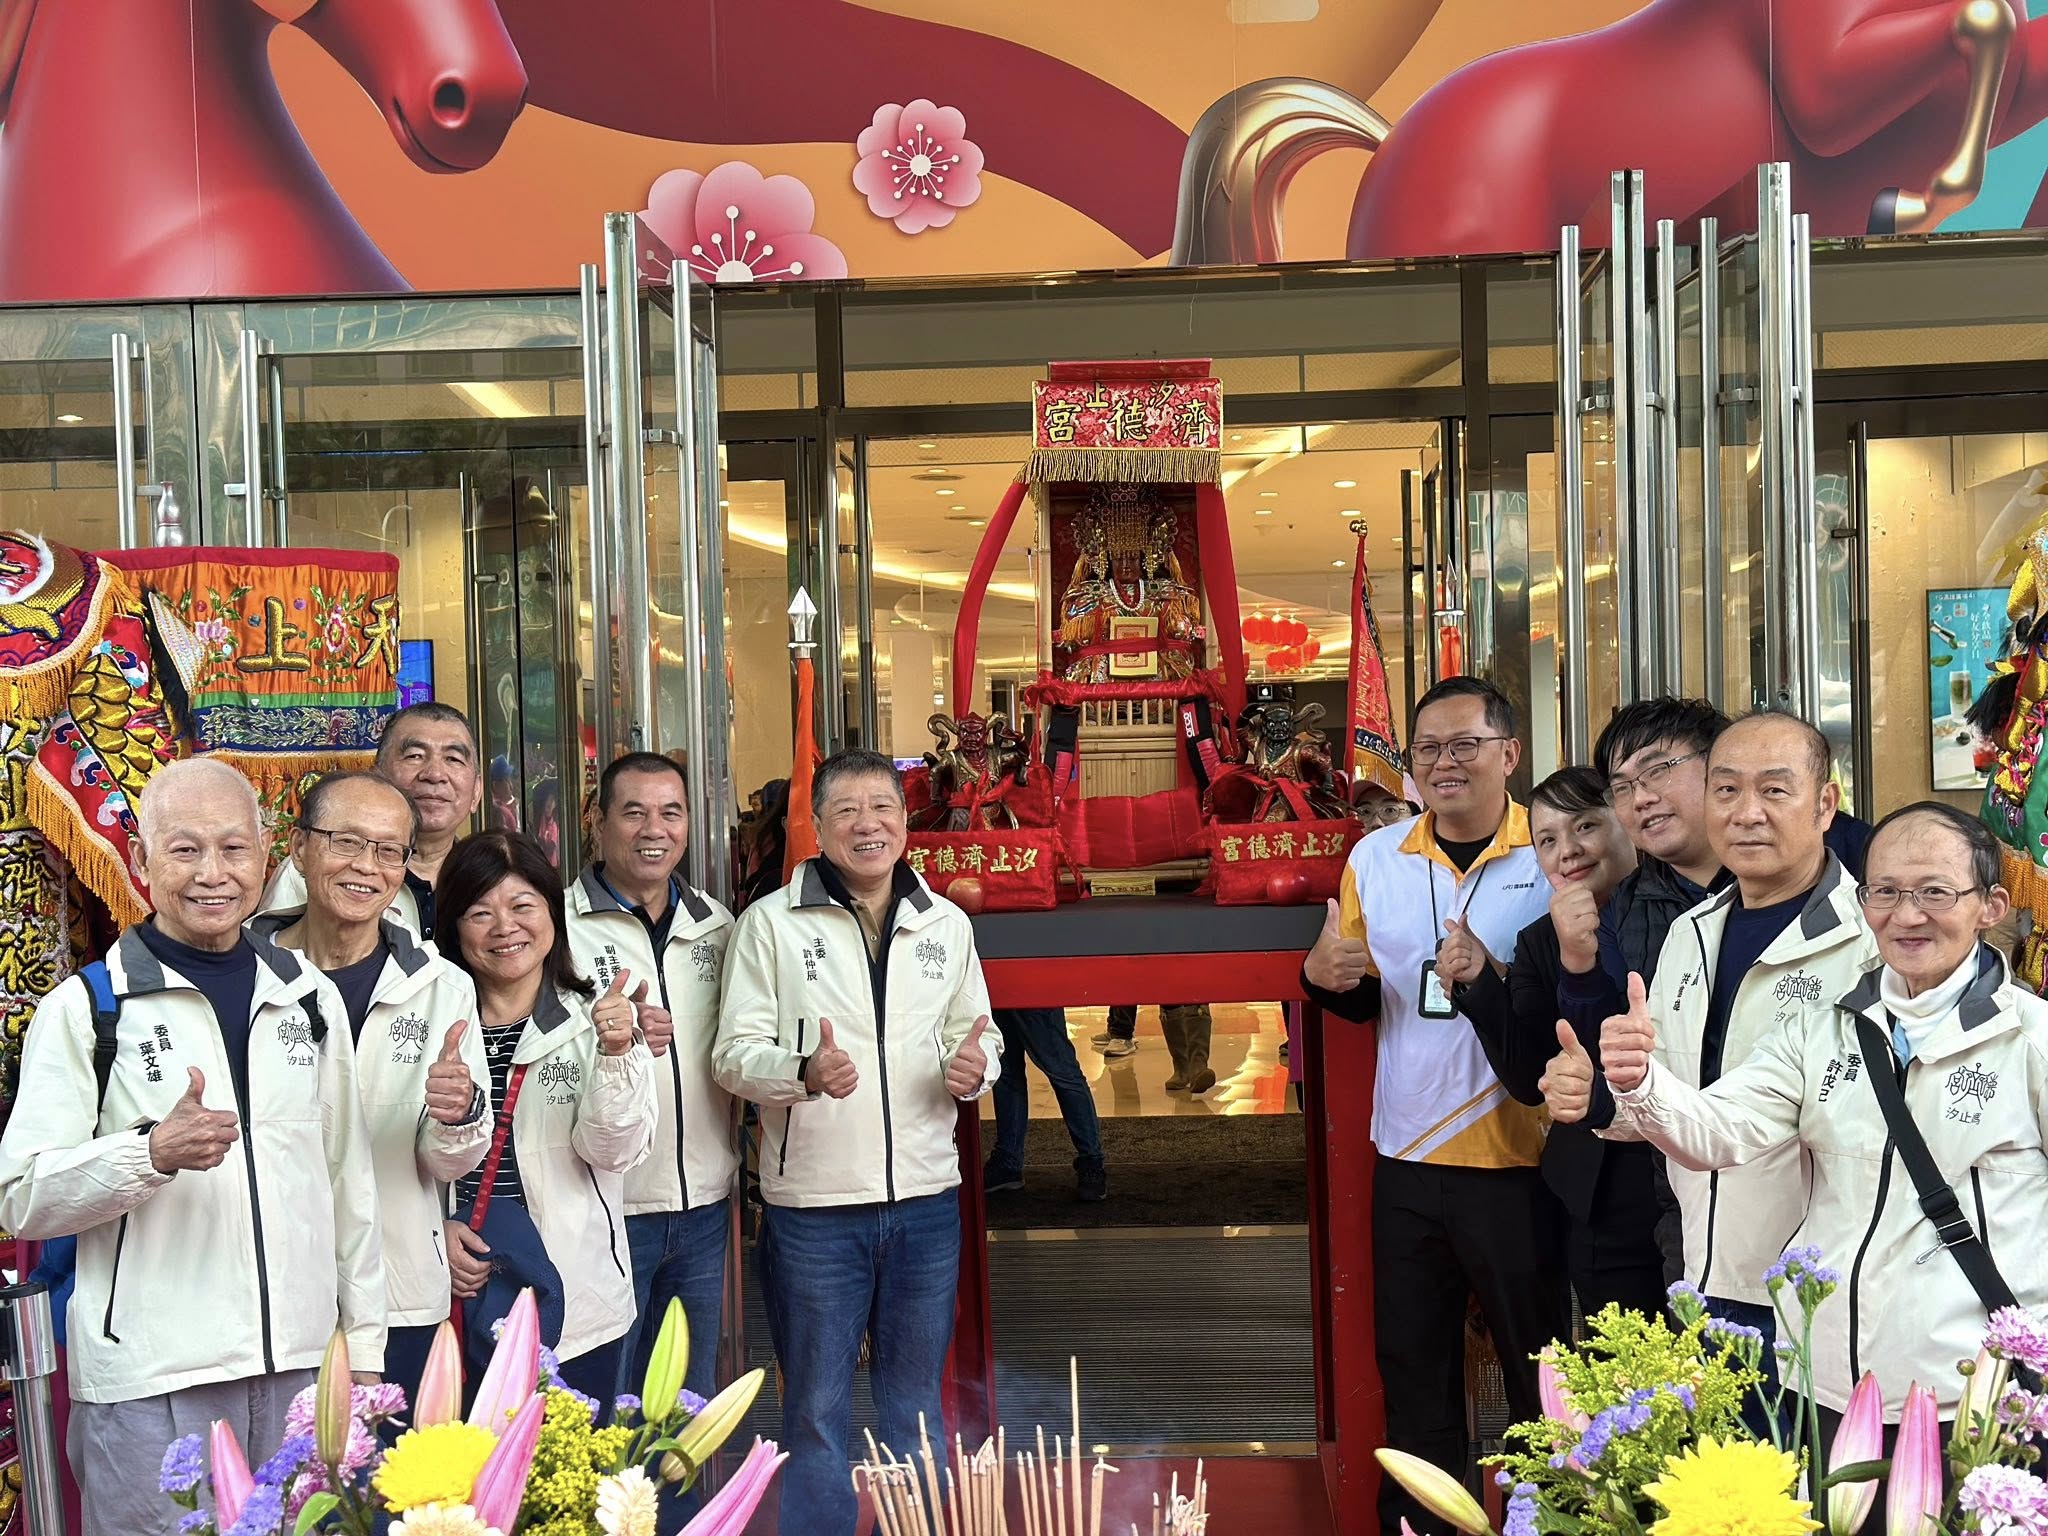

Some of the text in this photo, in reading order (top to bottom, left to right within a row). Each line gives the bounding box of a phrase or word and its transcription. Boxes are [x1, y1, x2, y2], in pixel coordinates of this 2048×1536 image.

[604, 944, 622, 976] 副主委
[813, 937, 826, 959] 主委
[802, 949, 818, 981] 許仲辰
[153, 1024, 173, 1052] 委員
[138, 1041, 163, 1083] 葉文雄
[1842, 1053, 1862, 1082] 委員
